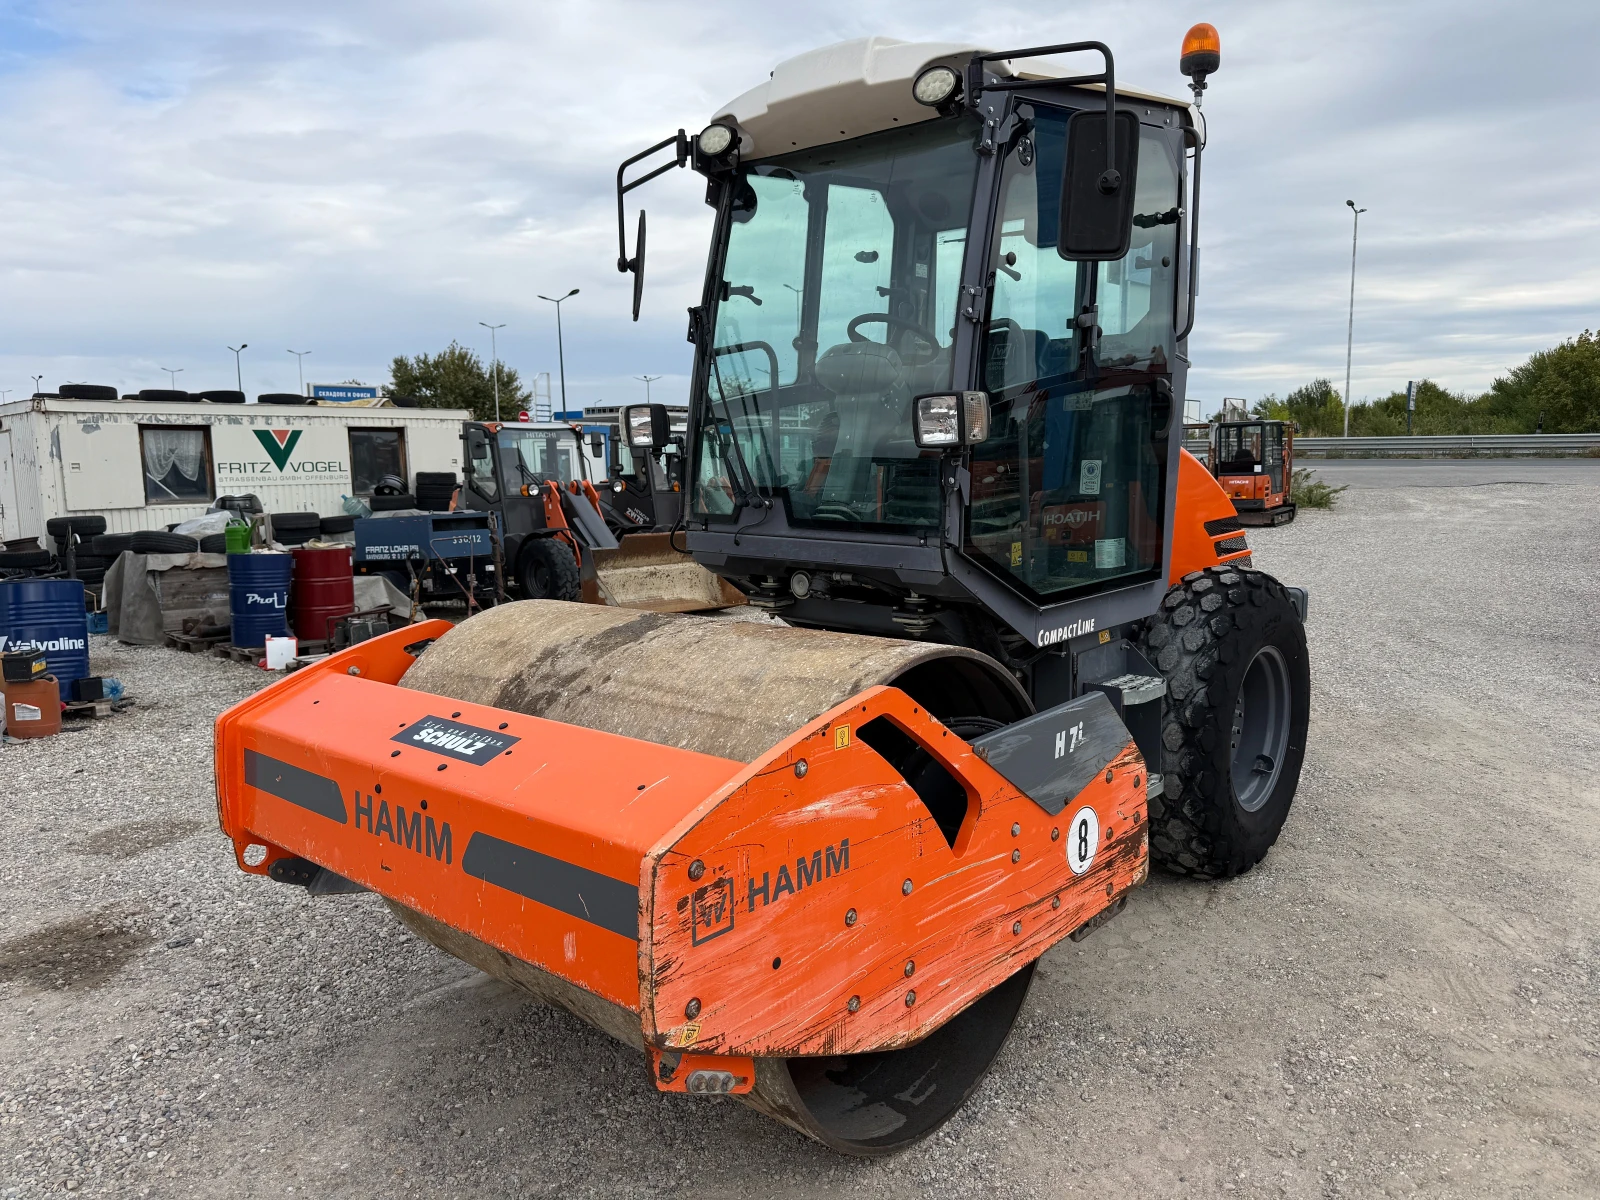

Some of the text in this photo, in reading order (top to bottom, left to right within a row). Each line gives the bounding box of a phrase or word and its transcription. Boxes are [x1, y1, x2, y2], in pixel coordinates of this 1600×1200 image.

[217, 461, 348, 474] FRITZ VOGEL
[626, 507, 644, 525] ZW75
[634, 507, 650, 522] HITACHI
[365, 545, 389, 554] FRANZ
[389, 544, 409, 553] LOHR
[7, 637, 85, 652] Valvoline
[412, 728, 487, 756] SCHULZ
[354, 789, 453, 866] HAMM
[1078, 818, 1089, 863] 8
[748, 838, 850, 914] HAMM
